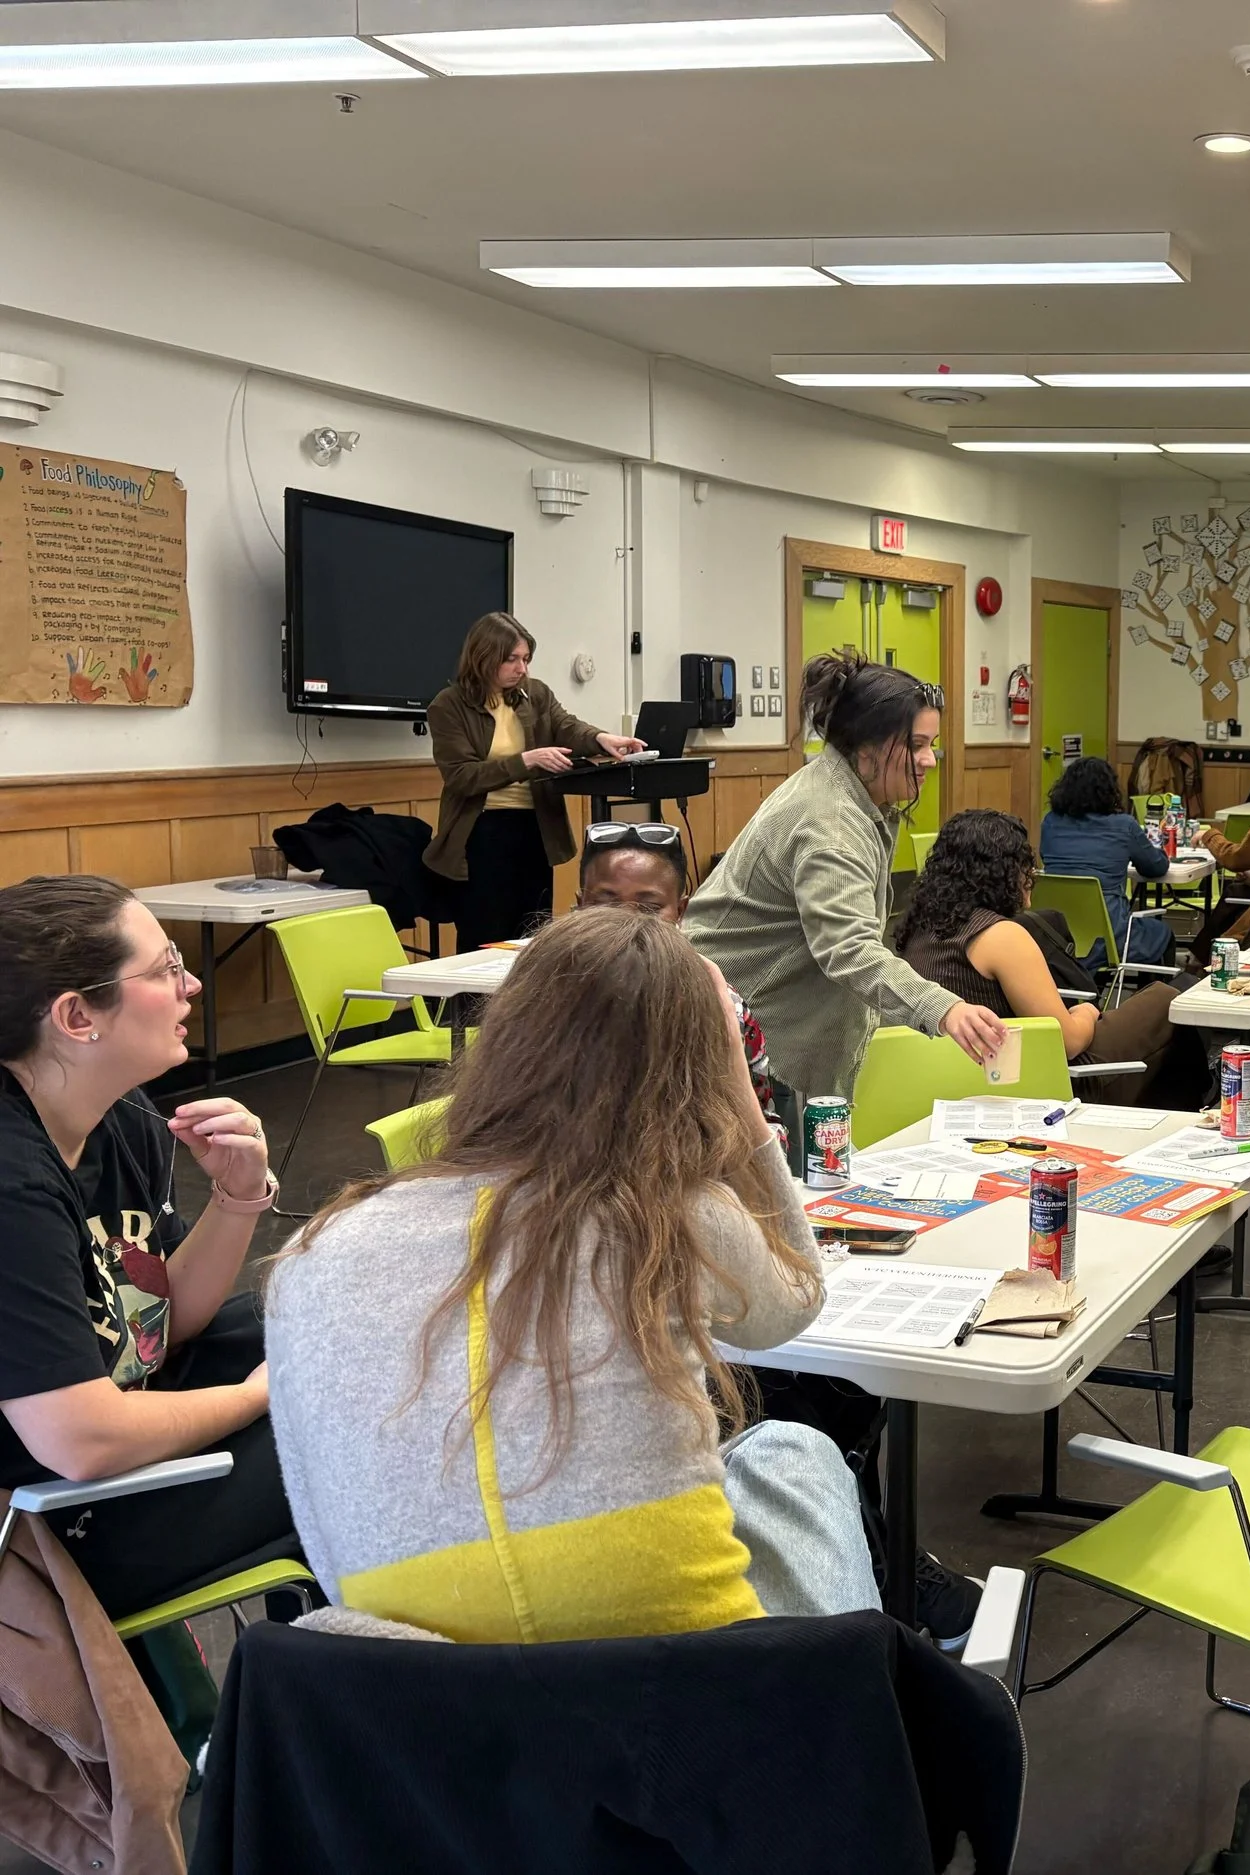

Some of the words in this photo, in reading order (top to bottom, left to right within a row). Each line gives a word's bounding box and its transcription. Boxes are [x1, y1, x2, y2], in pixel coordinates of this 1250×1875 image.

[40, 458, 72, 483] Food
[76, 464, 142, 504] Philosophy
[884, 519, 904, 550] EXIT
[1030, 1199, 1066, 1207] PELLEGRINO
